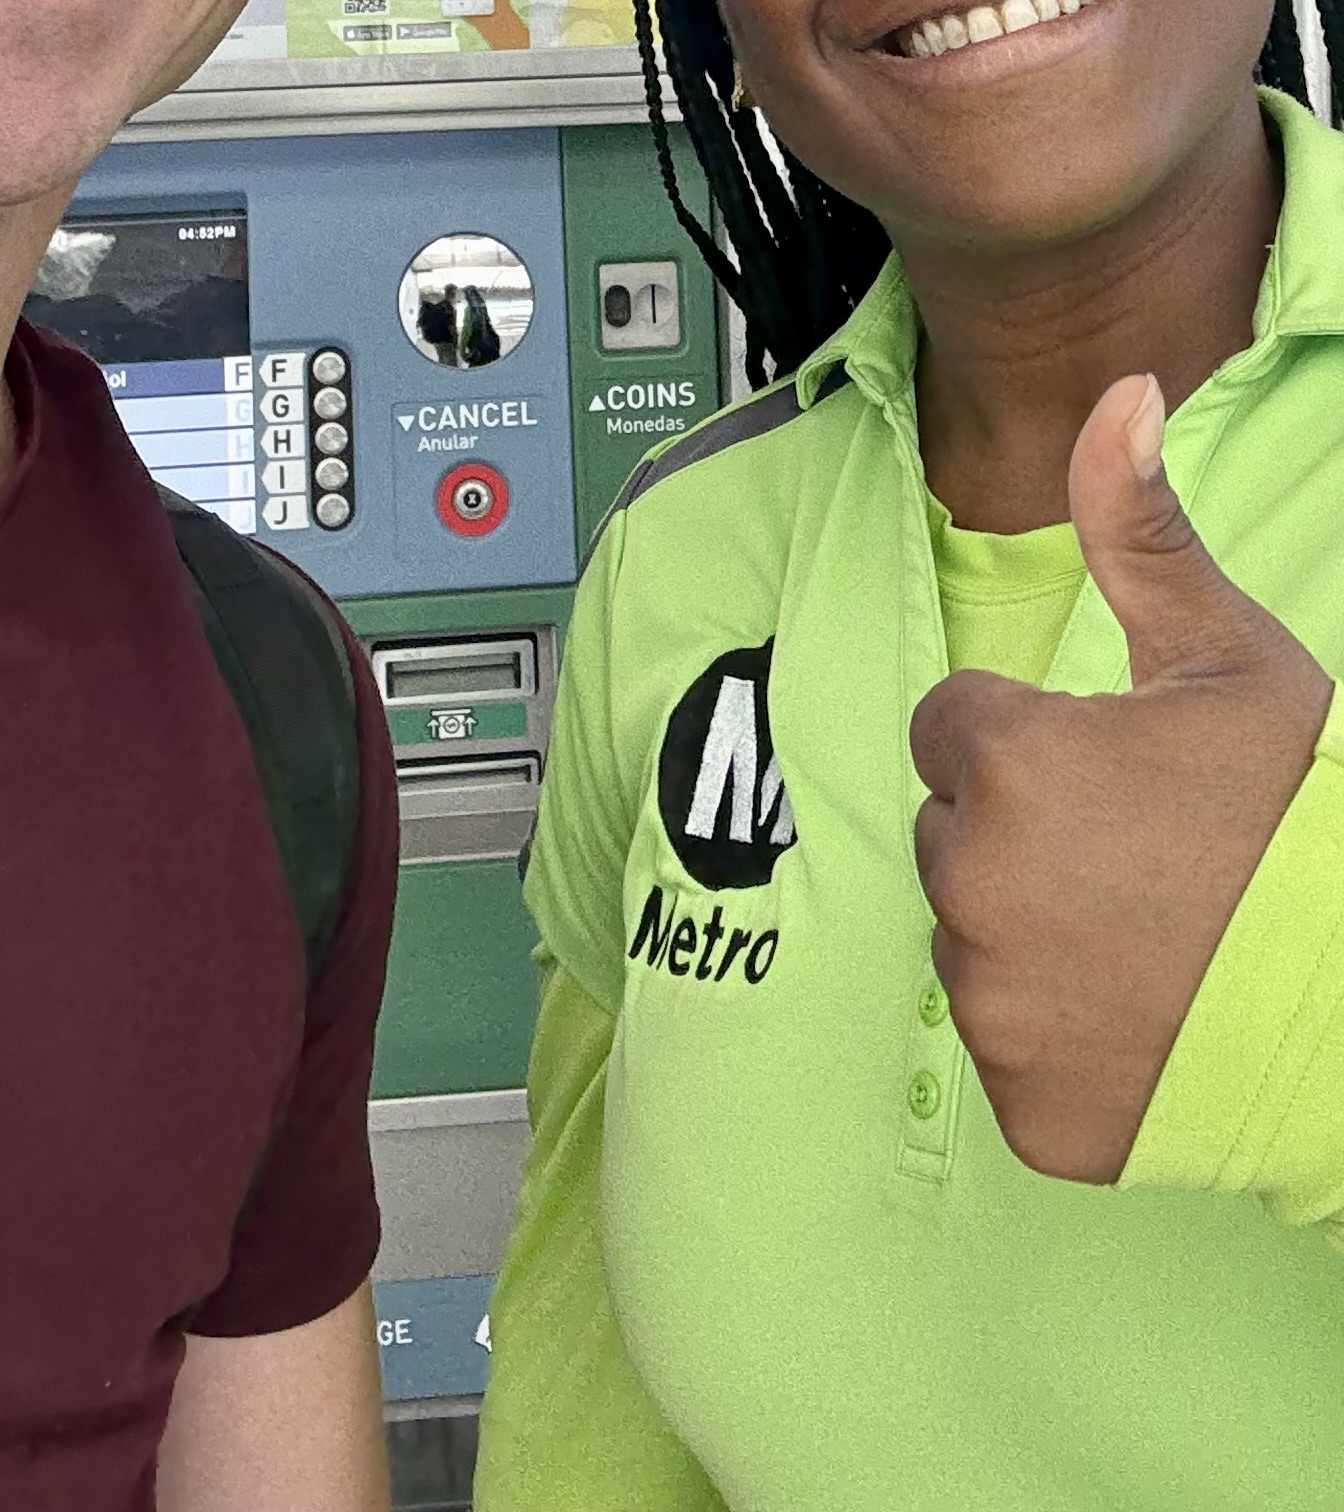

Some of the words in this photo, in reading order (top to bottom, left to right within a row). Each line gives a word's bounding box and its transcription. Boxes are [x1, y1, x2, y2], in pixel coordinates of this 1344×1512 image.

[234, 361, 251, 387] F
[271, 358, 288, 383] F
[271, 393, 290, 418] G
[607, 381, 696, 410] COINS
[418, 401, 538, 431] CANCEL
[606, 414, 686, 435] Monedas
[273, 429, 292, 454] H
[417, 434, 480, 453] Anular
[279, 464, 286, 490] I
[273, 500, 288, 526] J
